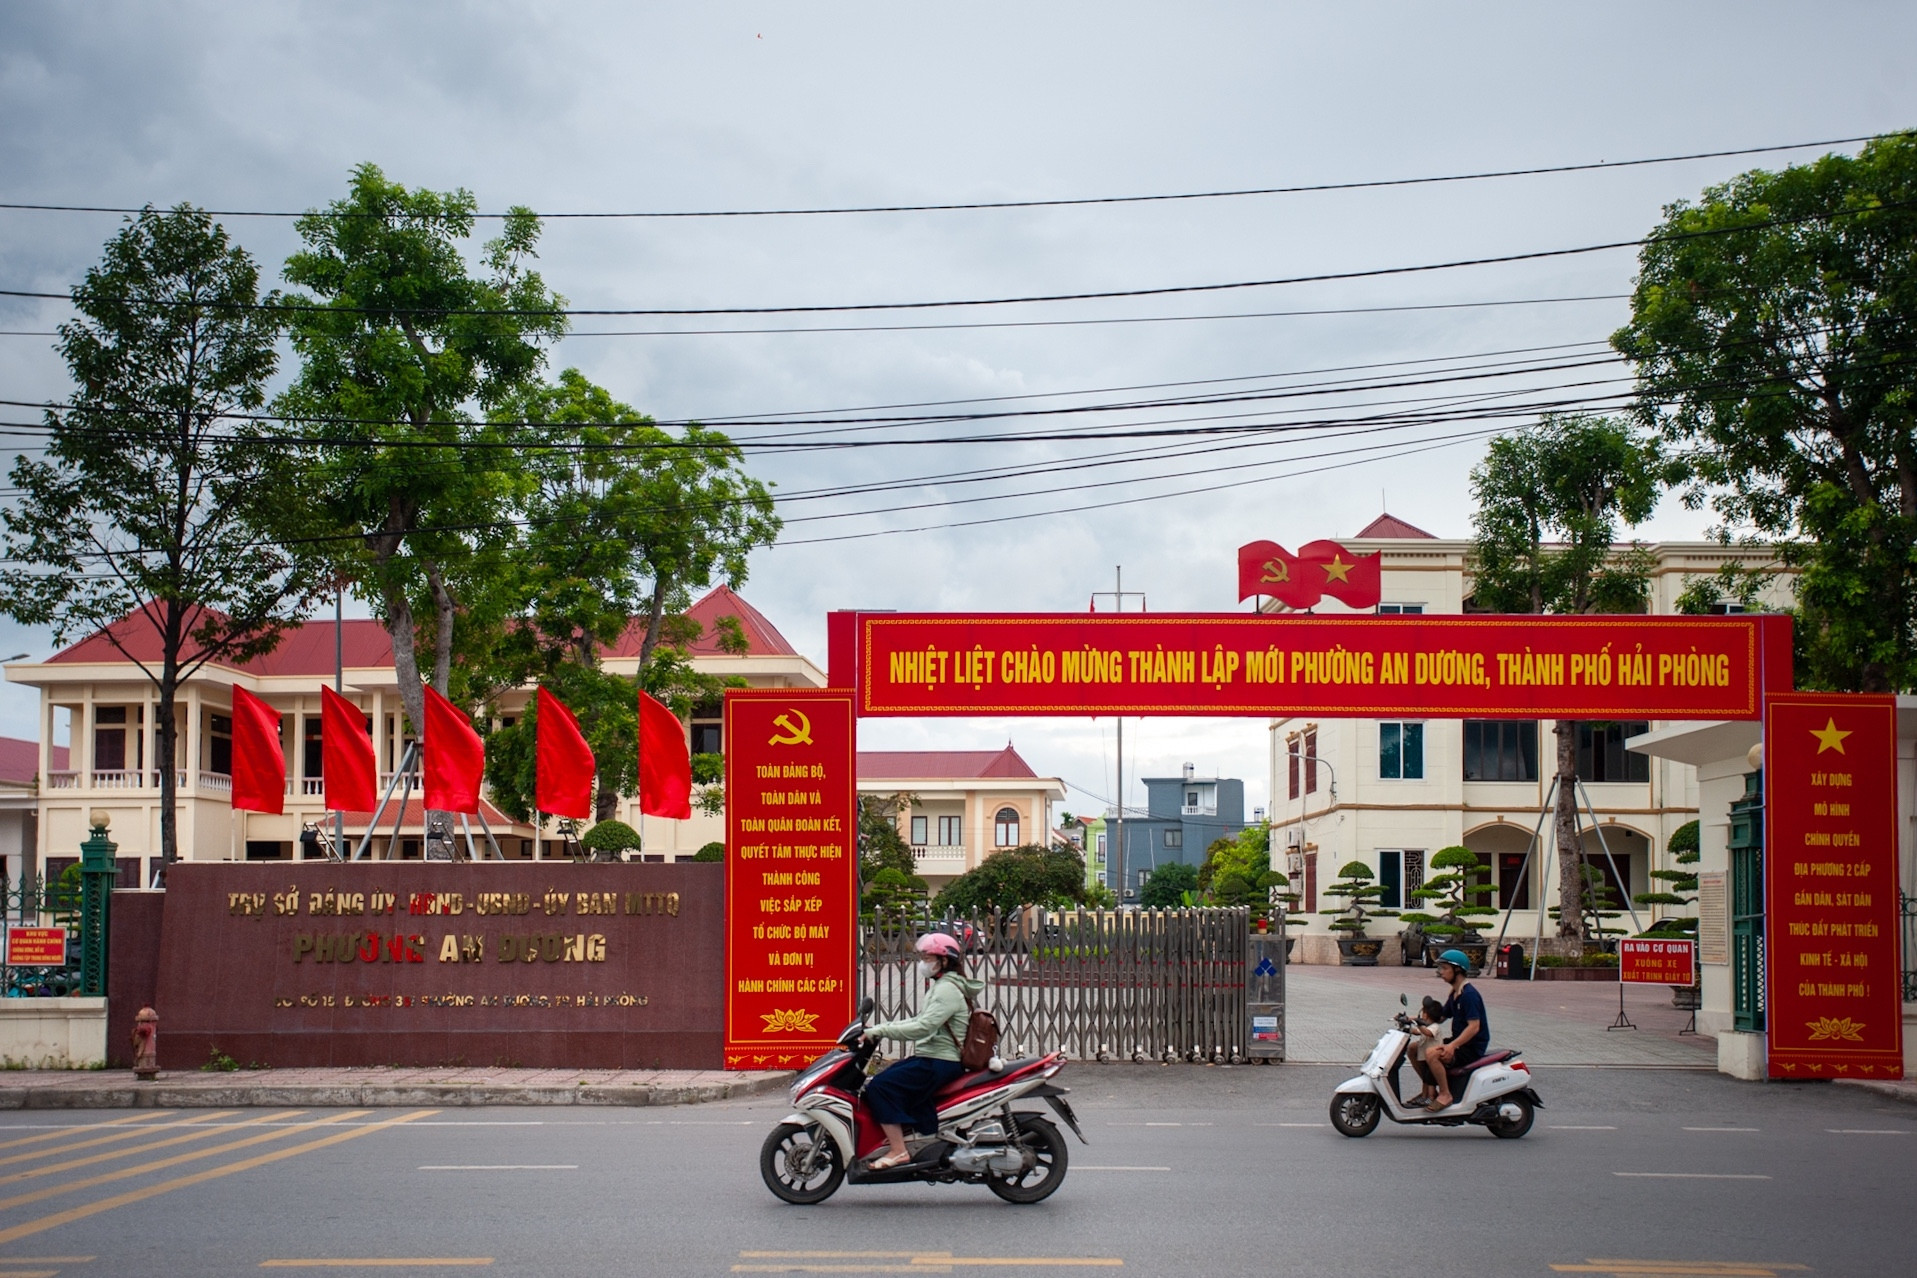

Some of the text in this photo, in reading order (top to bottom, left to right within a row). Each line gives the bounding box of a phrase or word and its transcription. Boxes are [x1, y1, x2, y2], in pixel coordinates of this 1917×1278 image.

[889, 642, 1730, 691] NHIỆT LIỆT CHÀO MỪNG THÀNH LẬP MỚI PHƯỜNG AN DƯƠNG, THÀNH PHỐ HẢI PHÒNG
[756, 761, 826, 781] TOÀN ĐẢNG BỘ,
[1811, 770, 1853, 789] XÂY DỰNG
[761, 789, 822, 805] TOÀN DÂN VÀ
[1814, 801, 1850, 816] MÔ HÌNH
[741, 815, 842, 833] TOÀN QUÂN ĐOÀN KẾT,
[1804, 830, 1831, 846] CHÍNH
[740, 842, 842, 861] QUYẾT TÂM THỰC HIỆN
[762, 869, 821, 886] THÀNH CÔNG
[1794, 860, 1872, 879] ĐỊA PHƯƠNG 2 CẤP
[228, 893, 266, 921] TRỤ
[273, 885, 299, 916] SỞ
[576, 892, 617, 916] BAN
[624, 892, 680, 918] MTTQ
[760, 895, 823, 915] VIỆC SẮP XẾP
[1813, 890, 1835, 907] DÂN,
[1836, 891, 1852, 906] SÁT
[1854, 891, 1872, 907] DÂN
[752, 921, 830, 941] TỔ CHỨC BỘ MÁY
[1788, 921, 1810, 936] THÚC
[1830, 921, 1852, 937] PHÁT
[1854, 919, 1878, 937] TRIỂN
[293, 929, 607, 964] PHƯỜNG AN DƯƠNG
[1624, 941, 1688, 954] RA VÀO CƠ QUAN
[768, 950, 814, 969] VÀ ĐƠN VỊ
[1667, 959, 1677, 968] XE
[1800, 953, 1821, 967] KINH
[1822, 950, 1832, 967] TẾ
[1840, 952, 1852, 967] XÃ
[1853, 951, 1868, 970] HỘI
[738, 977, 764, 993] HÀNH
[766, 977, 795, 993] CHÍNH
[797, 977, 816, 993] CÁC
[818, 975, 837, 993] CẤP
[1641, 970, 1662, 981] TRÌNH
[1798, 979, 1816, 997] CỦA
[1817, 981, 1845, 997] THÀNH
[1847, 980, 1865, 997] PHỐ
[577, 991, 599, 1007] HẢI
[603, 991, 648, 1008] PHÒNG
